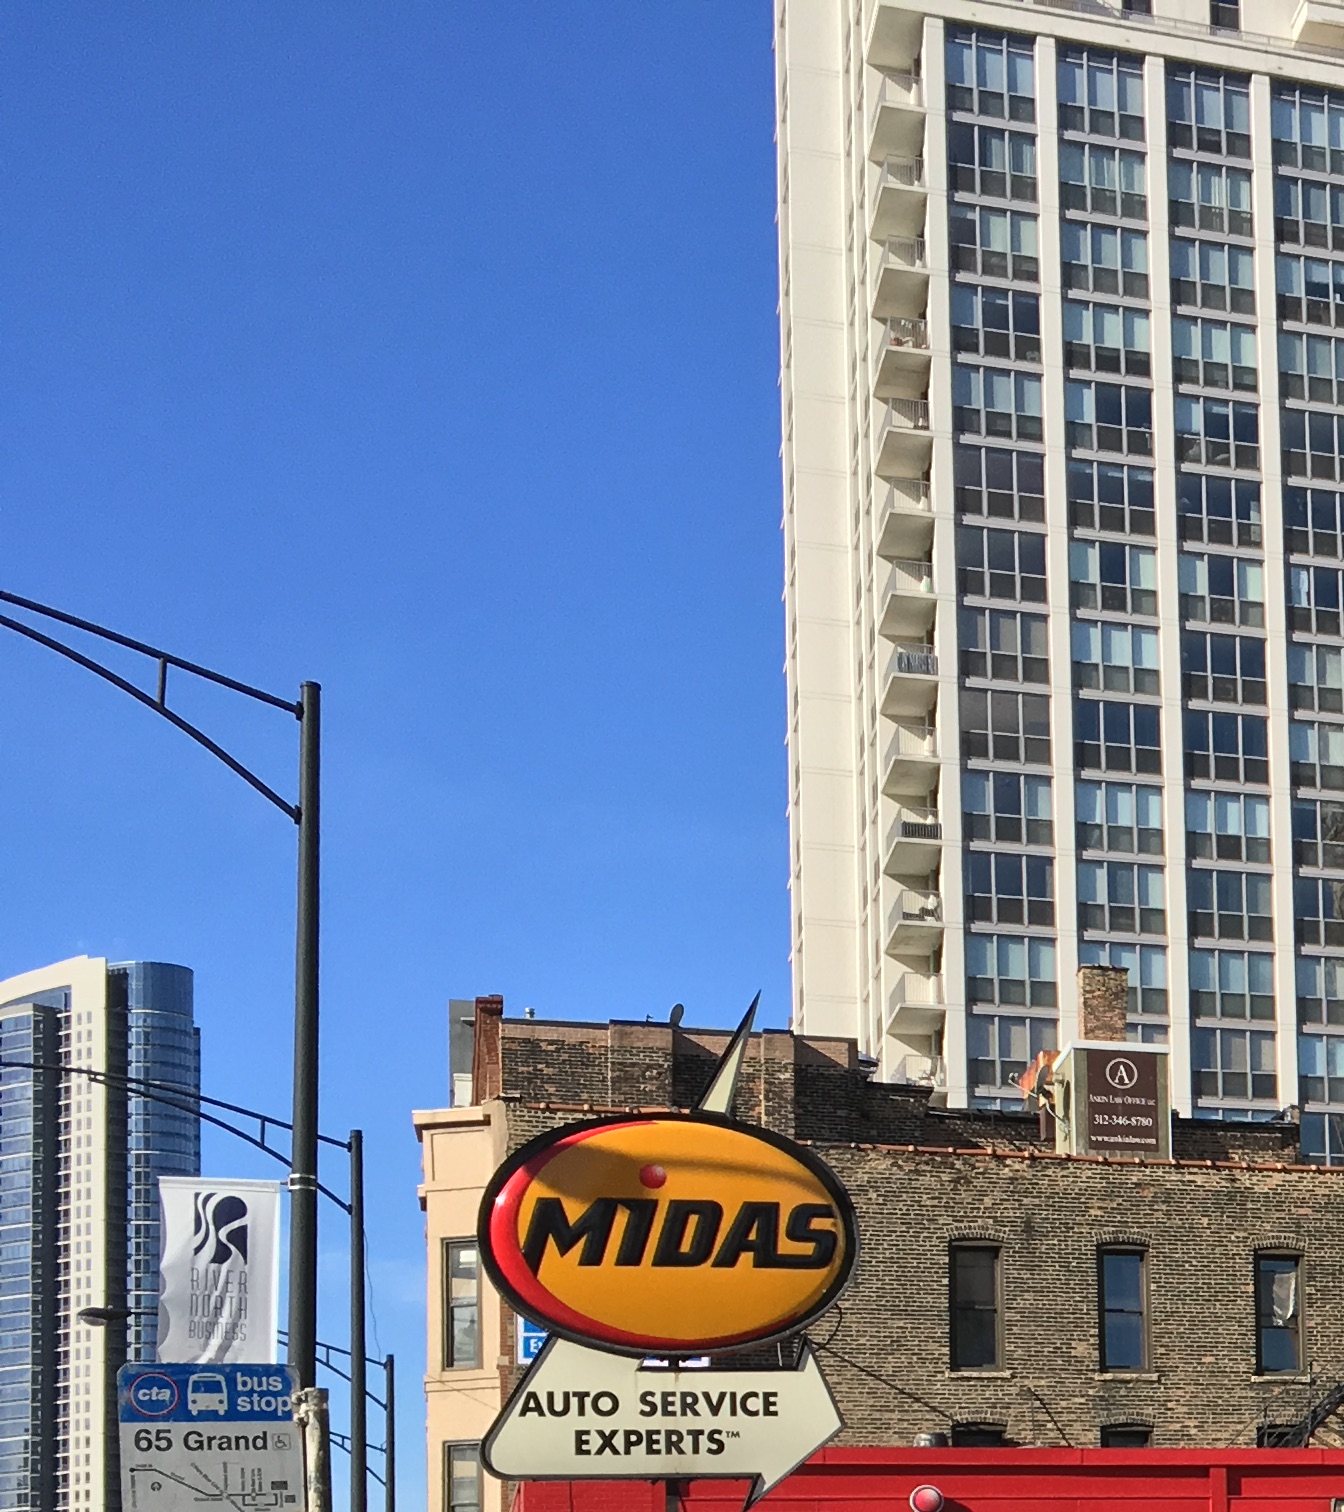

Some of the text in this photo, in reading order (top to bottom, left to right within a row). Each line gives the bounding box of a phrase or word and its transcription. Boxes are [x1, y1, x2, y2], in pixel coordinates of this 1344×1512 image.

[1094, 1115, 1153, 1127] 312-346-8780
[523, 1164, 838, 1279] MIDAS
[191, 1267, 249, 1294] RIVER
[190, 1294, 248, 1320] NORTH
[189, 1320, 247, 1342] BUSINESS
[237, 1372, 282, 1392] bus
[138, 1387, 171, 1403] cta
[237, 1396, 291, 1416] stop
[518, 1391, 779, 1417] AUTO SERVICE
[134, 1429, 268, 1451] 65 Grand
